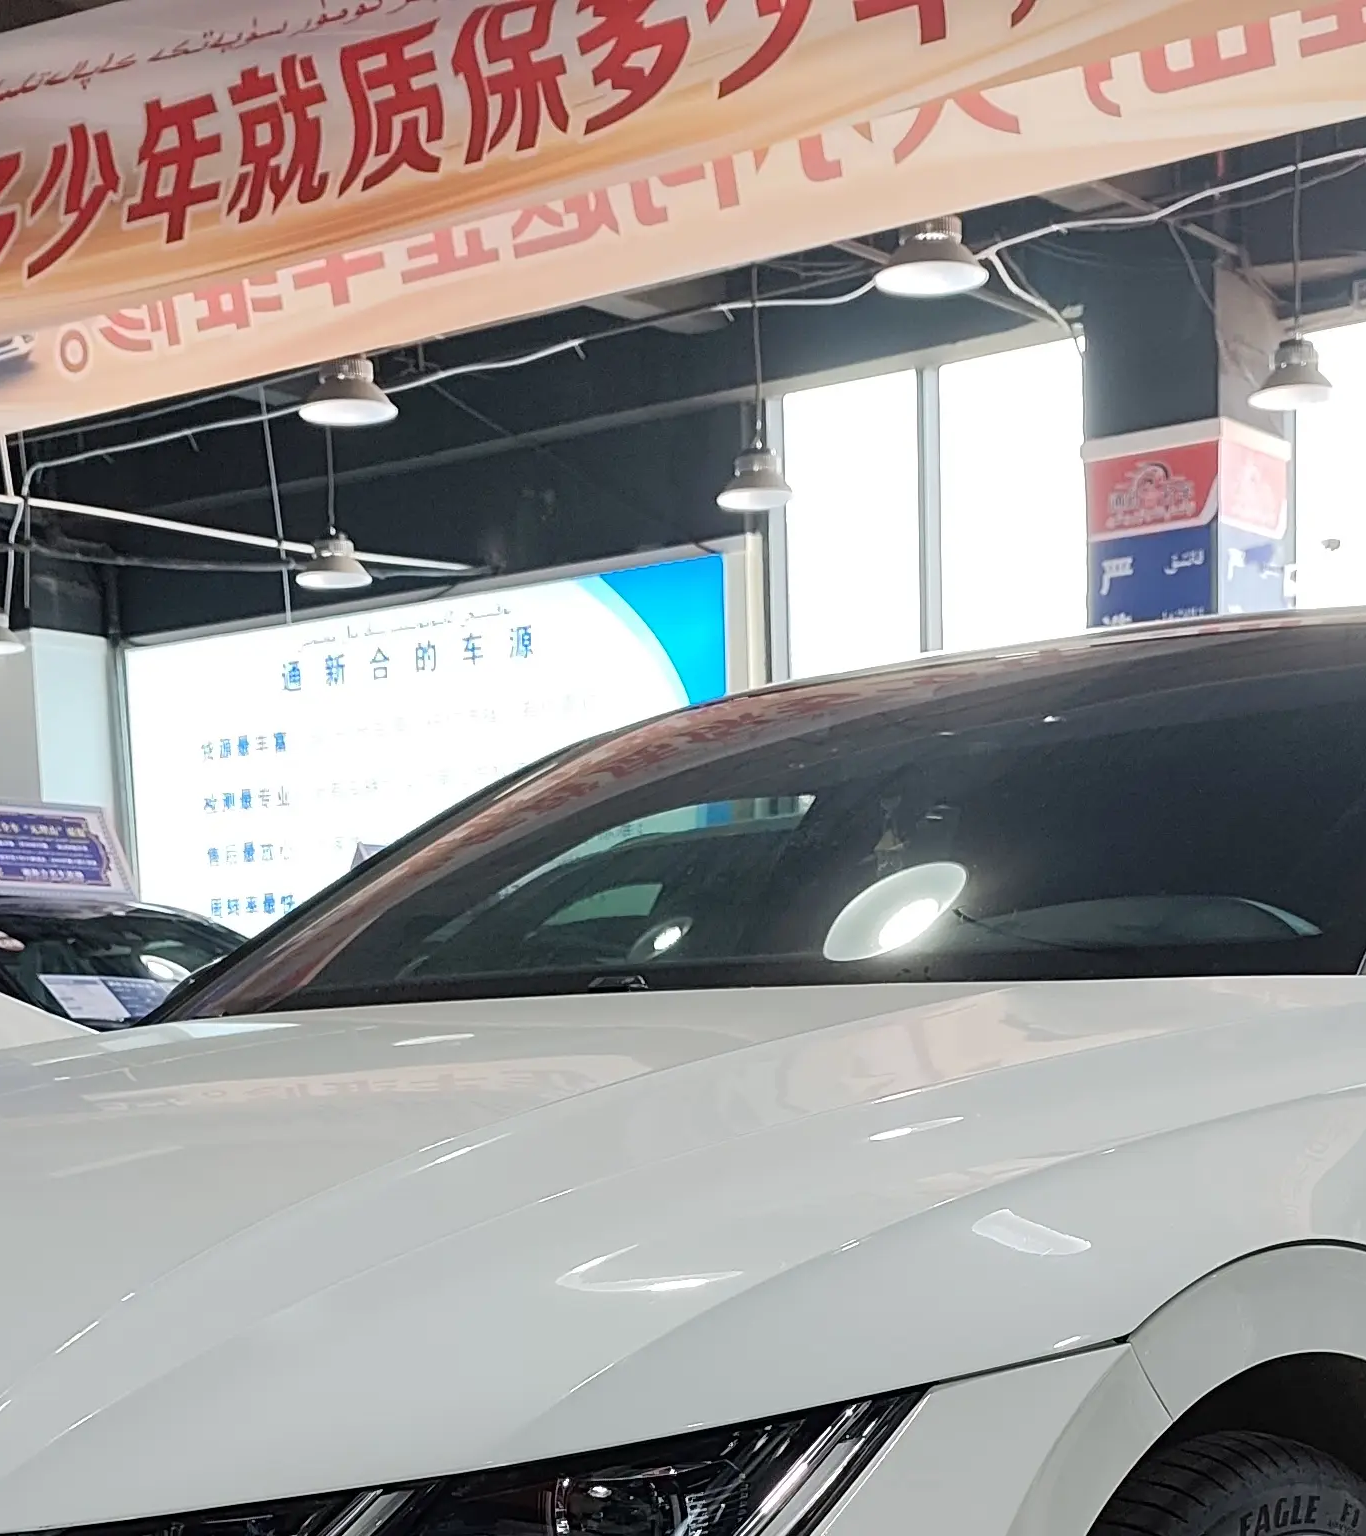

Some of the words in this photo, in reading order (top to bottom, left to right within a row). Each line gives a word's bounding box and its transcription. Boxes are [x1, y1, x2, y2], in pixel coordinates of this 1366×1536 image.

[281, 624, 534, 692] 通新合的车源
